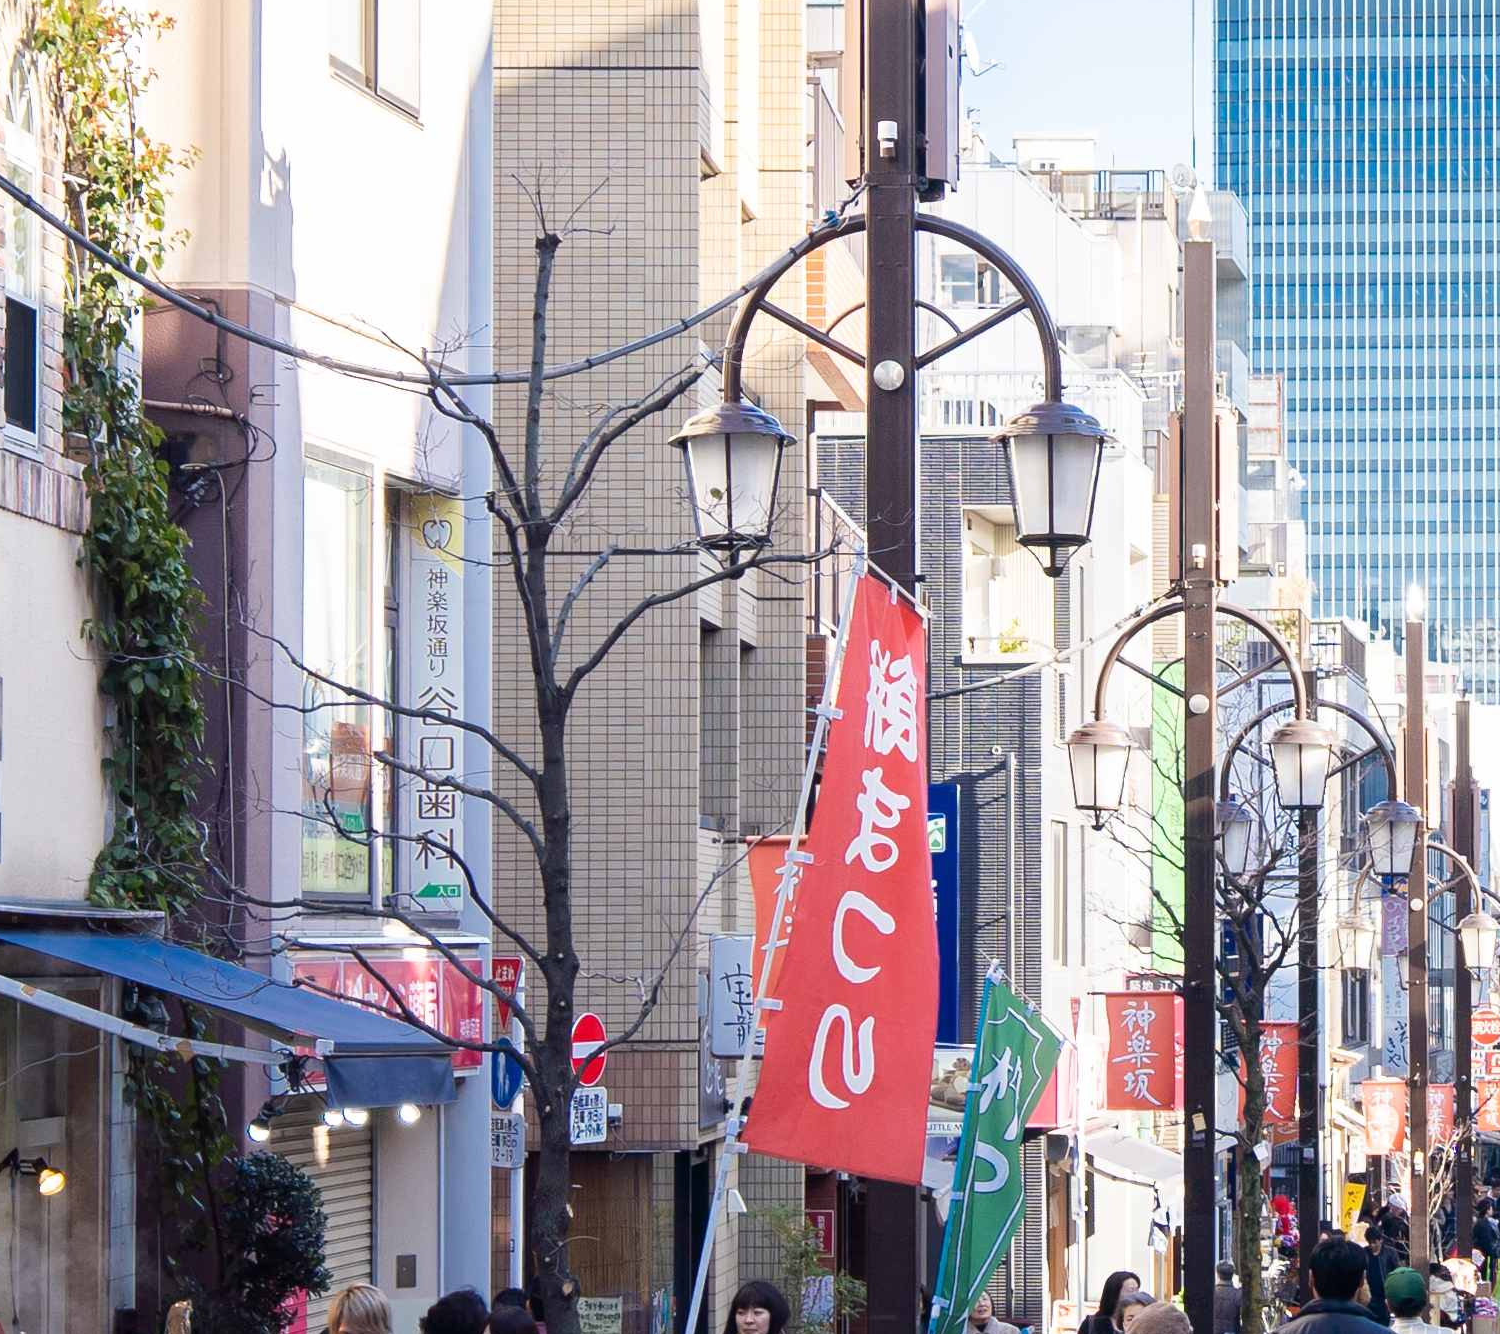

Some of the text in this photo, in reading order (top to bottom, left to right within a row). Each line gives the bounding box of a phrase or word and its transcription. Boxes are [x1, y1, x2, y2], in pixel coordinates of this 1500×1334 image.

[425, 567, 450, 679] 神楽坂通り
[414, 685, 459, 871] 谷口歯科
[435, 884, 460, 899] 入口
[1111, 1000, 1163, 1107] 神楽坂
[1366, 1085, 1398, 1151] 神楽坂
